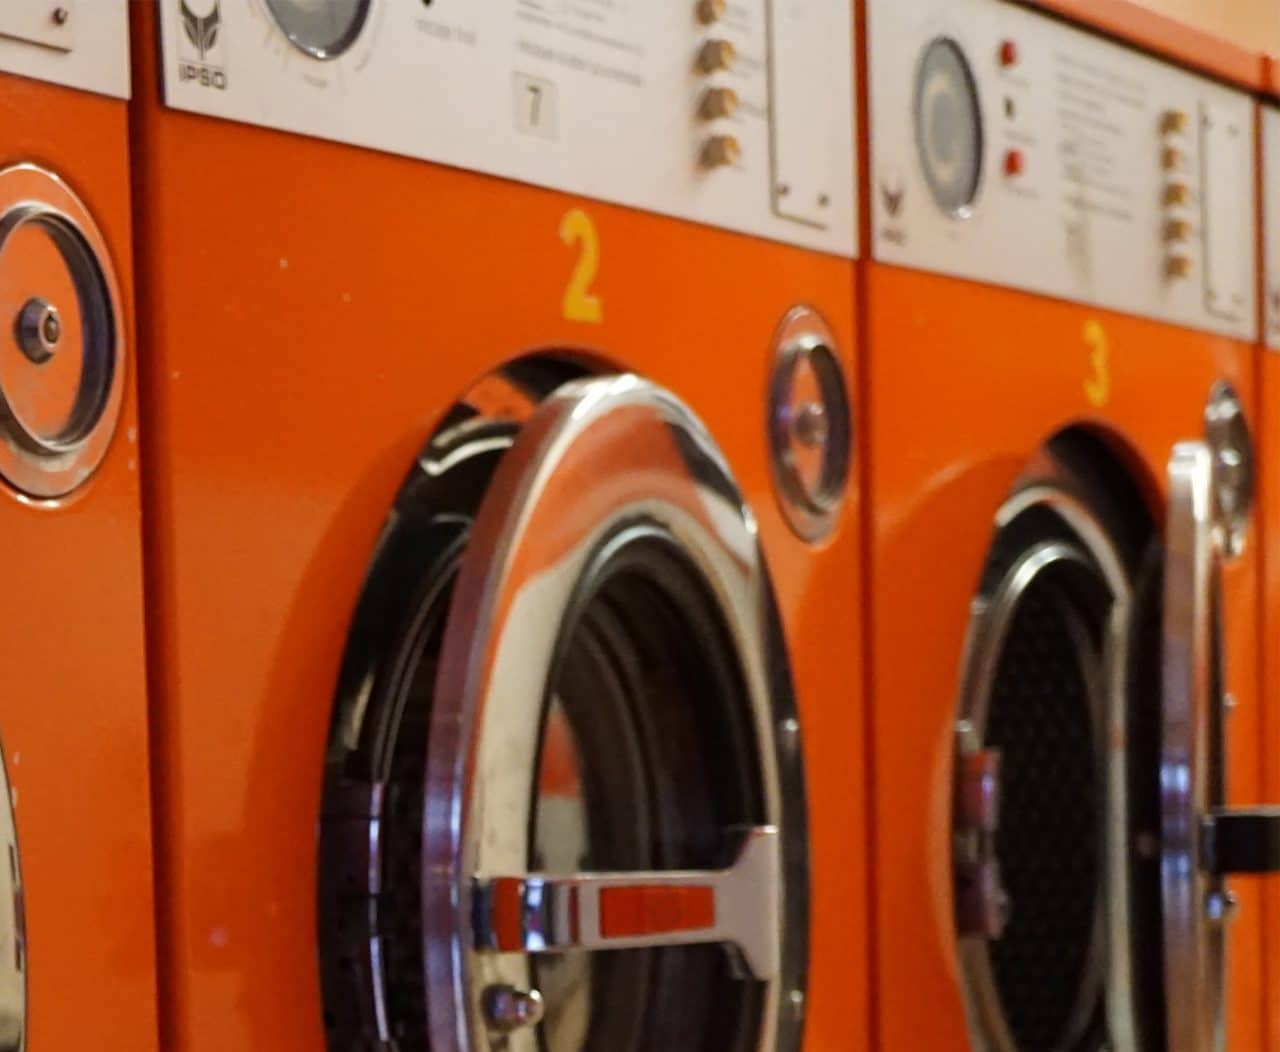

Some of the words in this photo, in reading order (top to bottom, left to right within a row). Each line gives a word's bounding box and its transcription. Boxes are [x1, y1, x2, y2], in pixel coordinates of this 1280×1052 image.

[178, 63, 227, 90] IPSO
[558, 208, 603, 324] 2
[1082, 319, 1111, 407] 3
